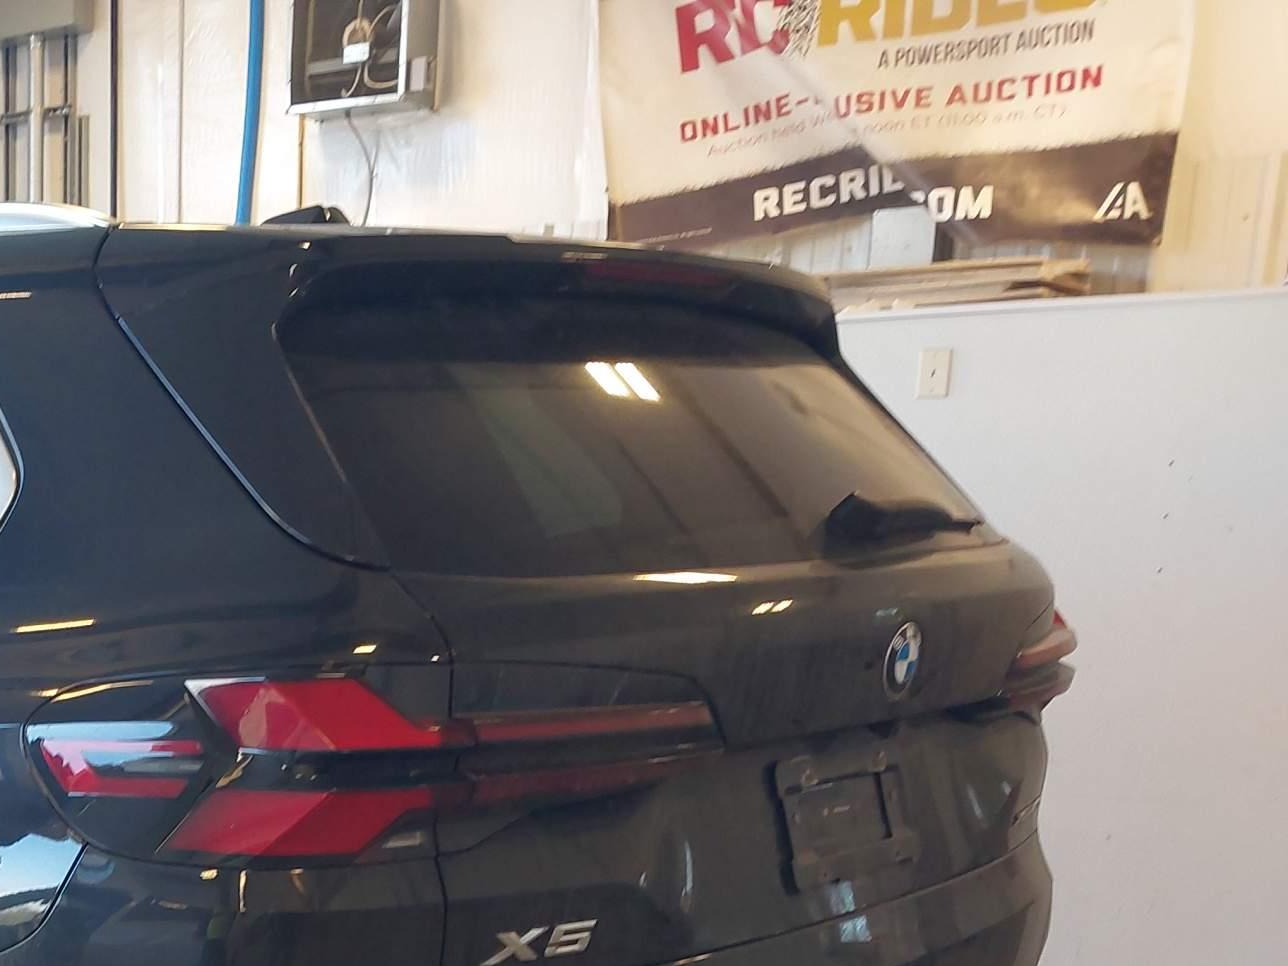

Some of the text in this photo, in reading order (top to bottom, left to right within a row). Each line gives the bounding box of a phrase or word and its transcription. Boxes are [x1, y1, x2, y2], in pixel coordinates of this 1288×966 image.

[877, 19, 1096, 69] A POWERSPORT AUCTION
[945, 64, 1104, 107] AUCTION
